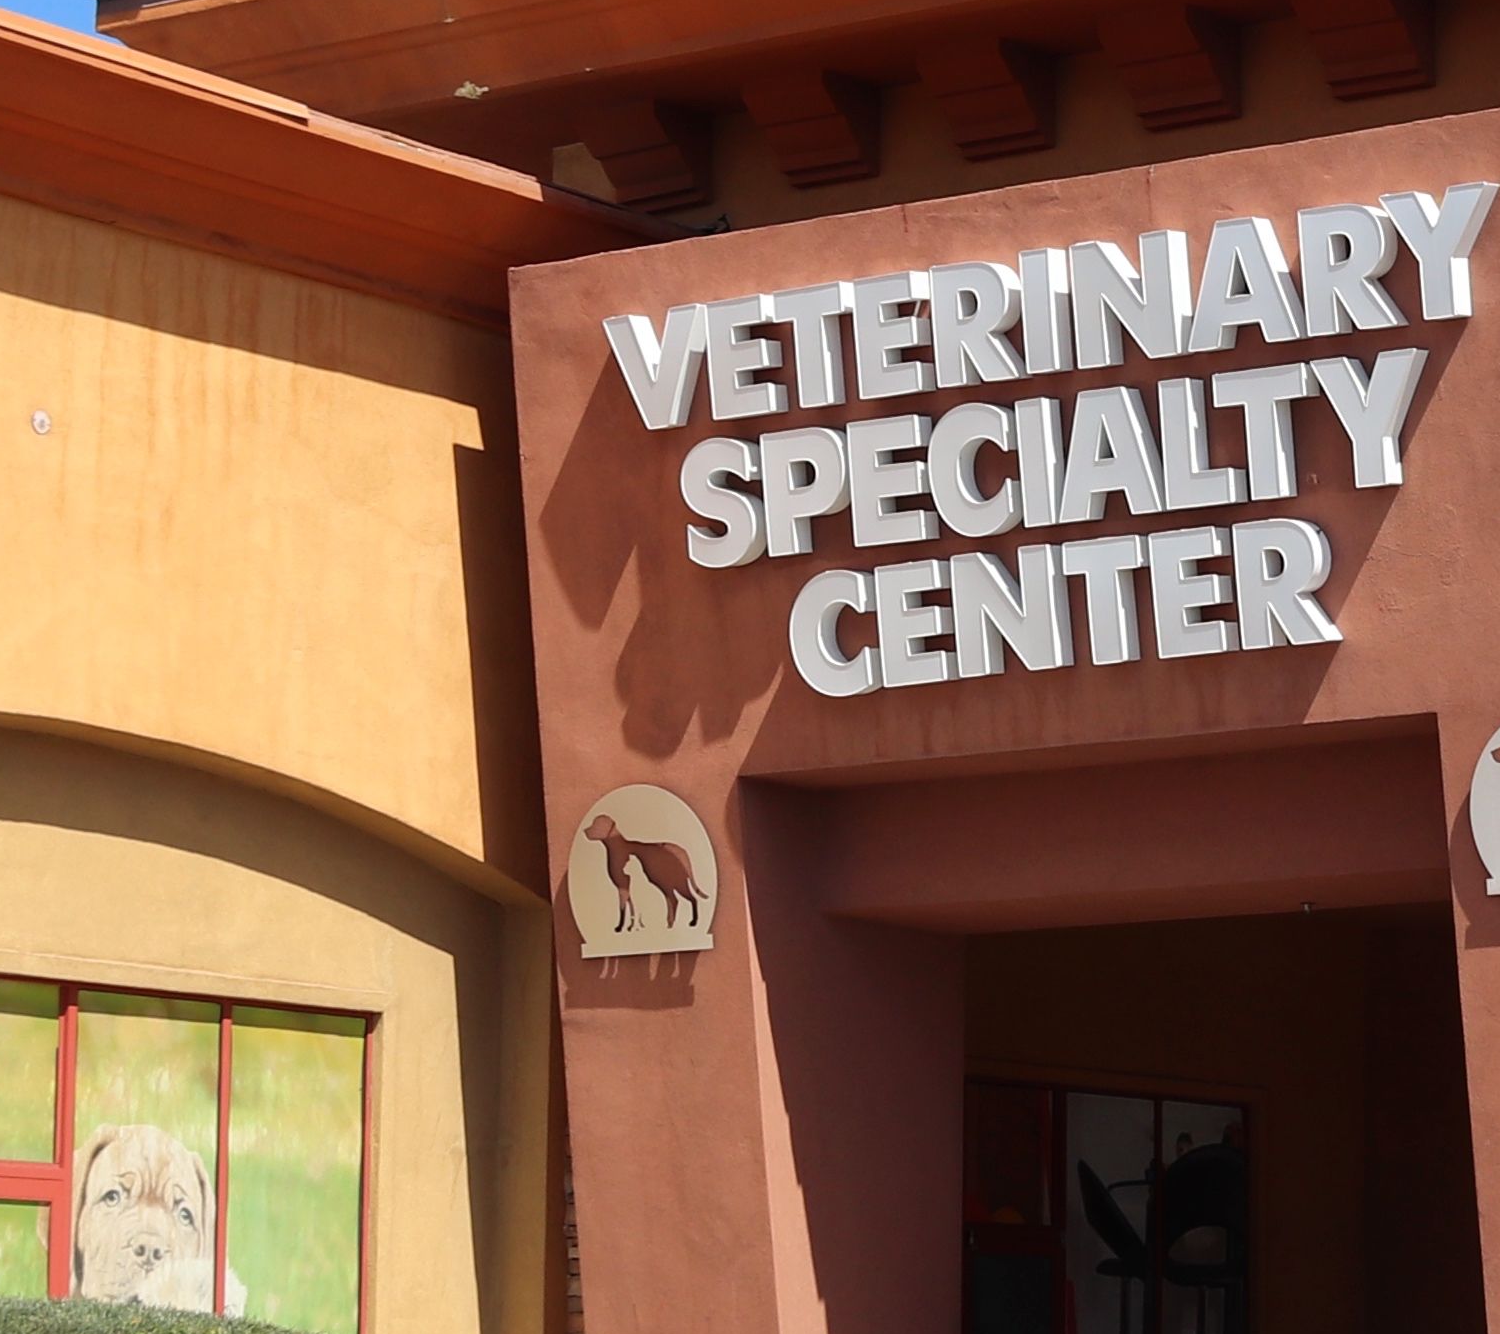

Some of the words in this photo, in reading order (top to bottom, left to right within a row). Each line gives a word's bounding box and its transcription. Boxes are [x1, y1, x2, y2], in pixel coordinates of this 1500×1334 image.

[601, 181, 1499, 430] VETERINARY
[678, 347, 1430, 568] SPECIALTY
[788, 518, 1343, 697] CENTER
